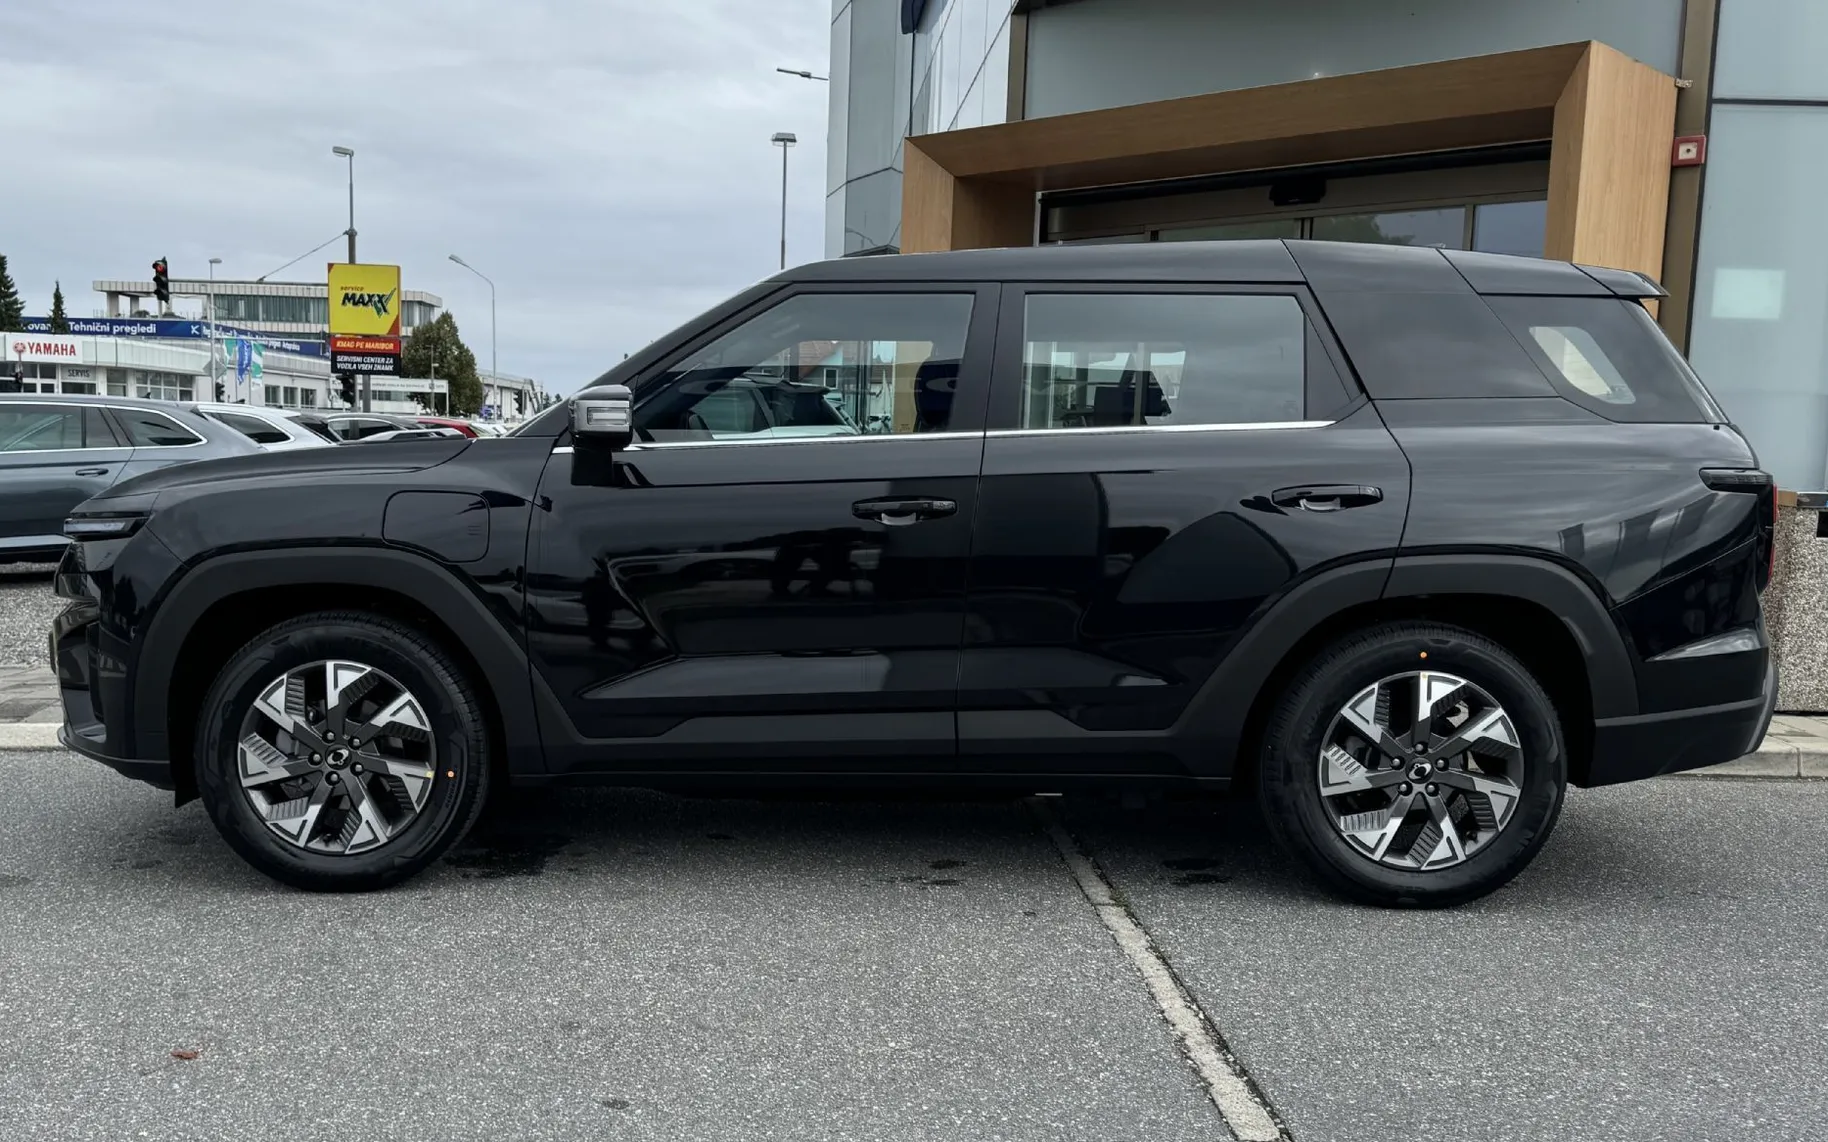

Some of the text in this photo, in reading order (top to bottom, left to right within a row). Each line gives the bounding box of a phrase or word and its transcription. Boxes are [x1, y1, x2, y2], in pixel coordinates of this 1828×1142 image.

[341, 292, 389, 314] MAXX
[69, 321, 157, 336] Tehnični pregledi
[27, 342, 76, 356] YAMAHA
[365, 342, 394, 350] MARIBOR
[336, 355, 362, 363] SERVISNI
[363, 356, 385, 364] CENTER
[68, 369, 90, 378] SERVIS
